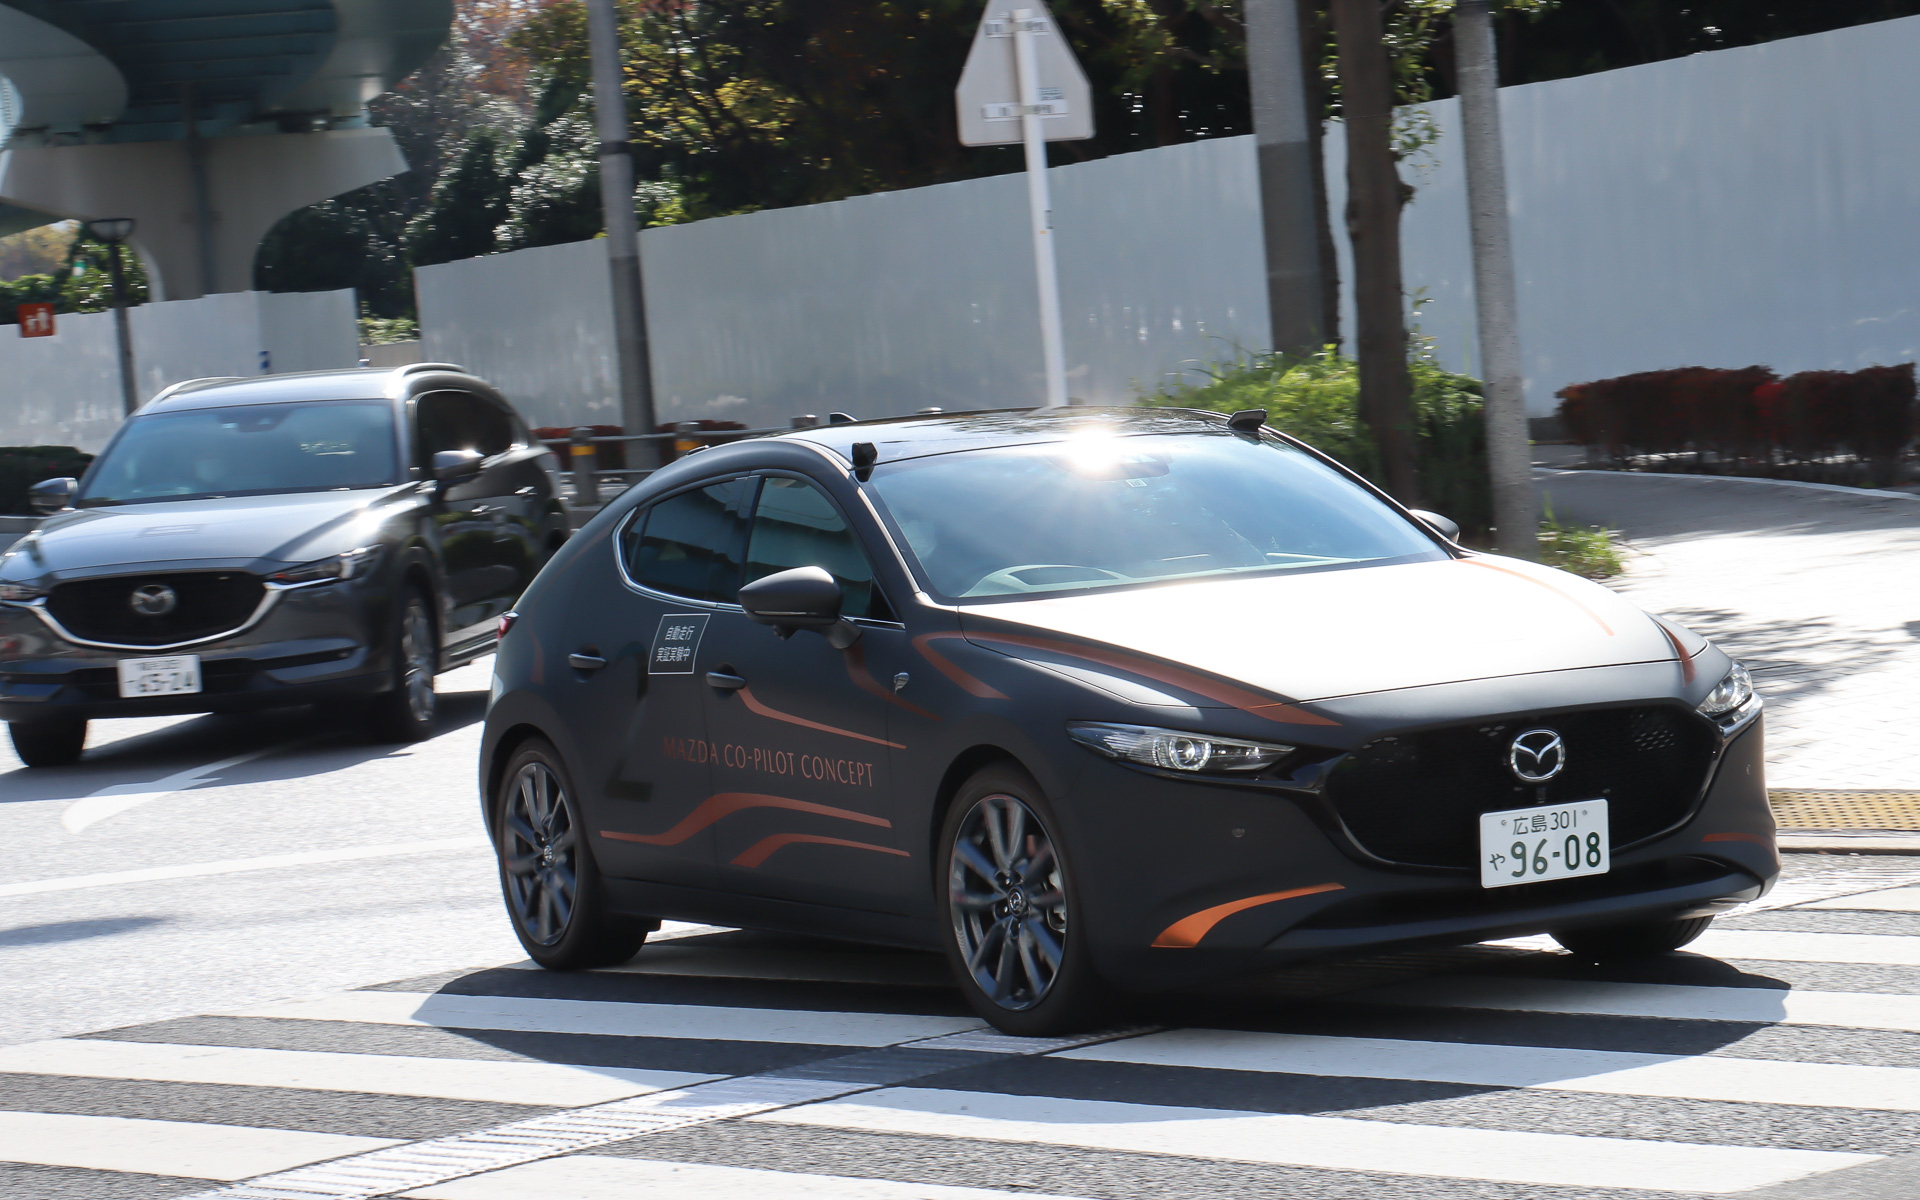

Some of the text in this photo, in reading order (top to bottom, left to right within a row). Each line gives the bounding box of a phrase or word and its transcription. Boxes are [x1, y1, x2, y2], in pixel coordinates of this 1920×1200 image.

[665, 625, 695, 641] 自動走行
[656, 646, 691, 662] 実証実験中
[663, 736, 873, 787] MAZDA CO-PILOT CONCEPT
[1513, 810, 1577, 836] 広島 301
[1489, 831, 1601, 878] や 96-08
